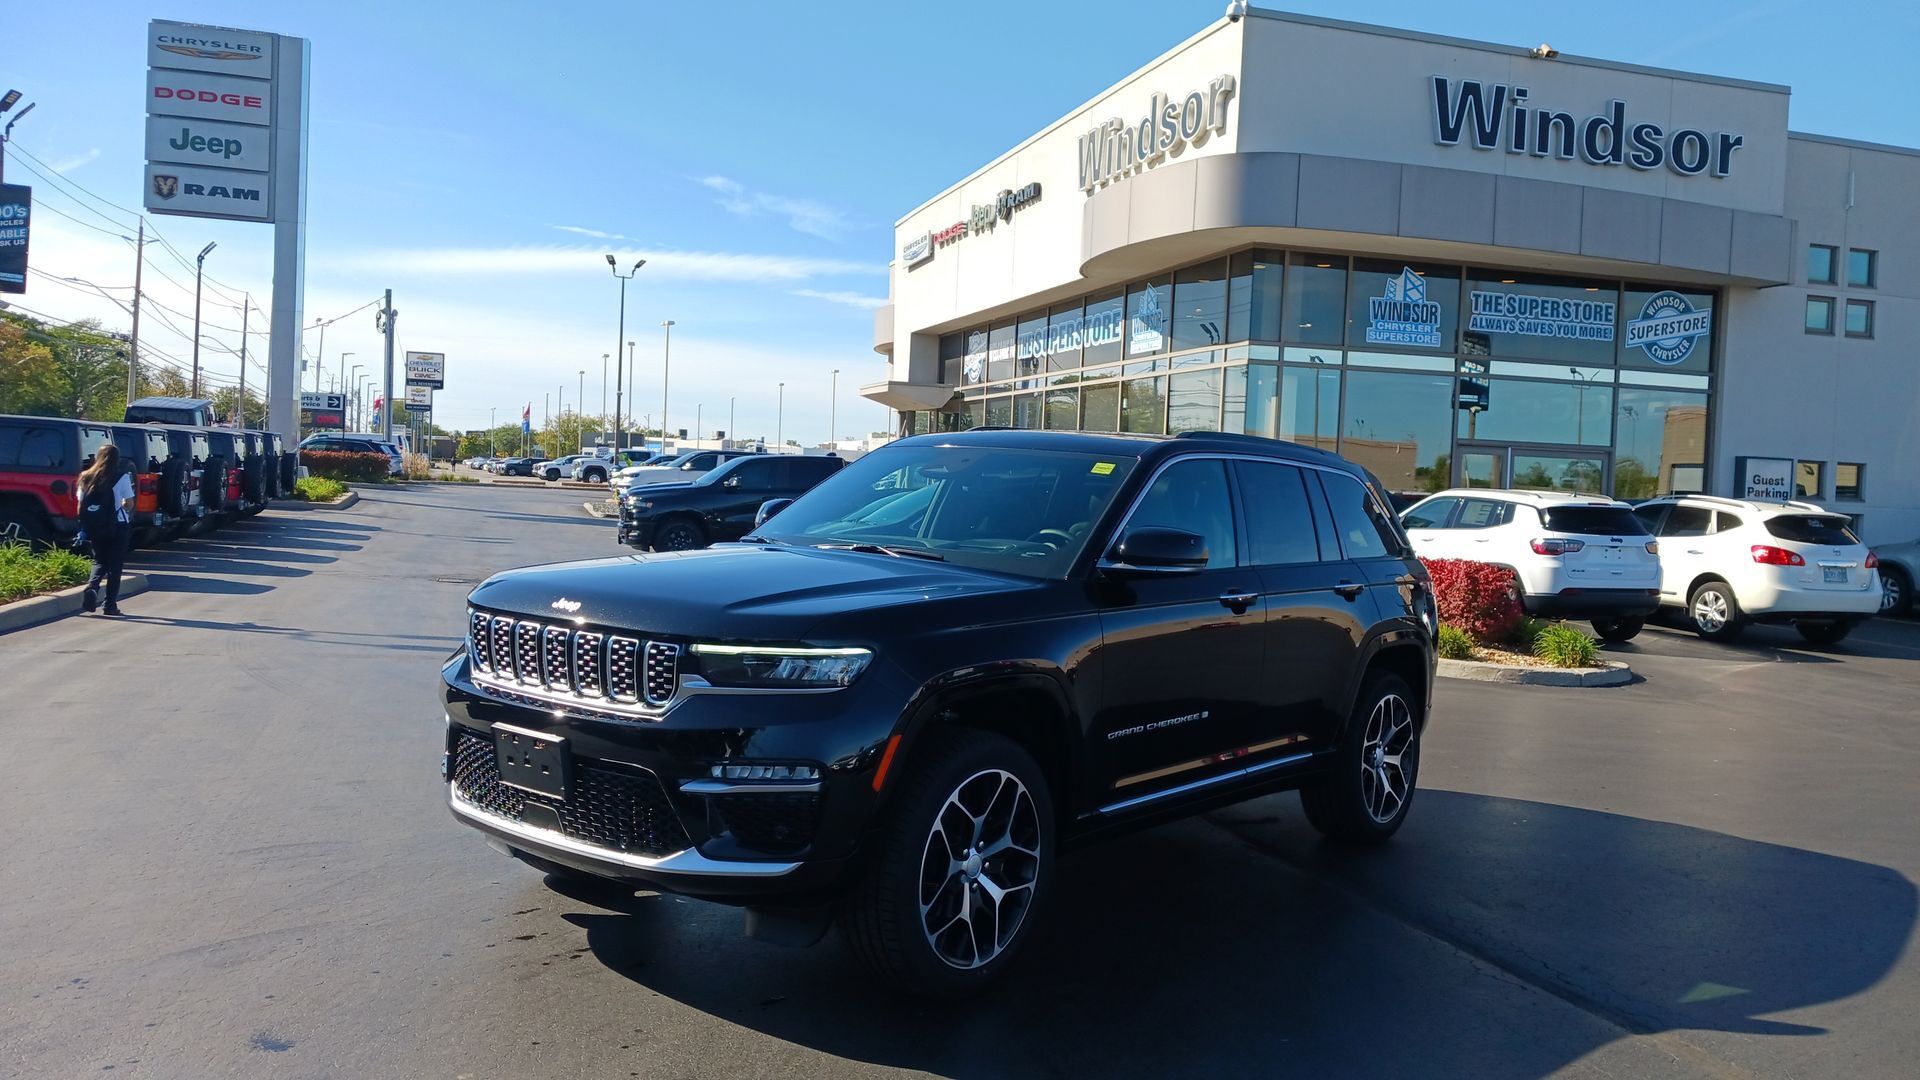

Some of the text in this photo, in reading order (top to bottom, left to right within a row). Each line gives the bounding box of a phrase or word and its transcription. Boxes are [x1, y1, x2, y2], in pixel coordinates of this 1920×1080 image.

[157, 35, 262, 53] CHRYSLER
[154, 86, 262, 108] DODGE
[1077, 74, 1235, 192] Windsor
[1431, 74, 1744, 177] Windsor
[169, 128, 242, 159] Jeep
[183, 183, 260, 201] RAM
[1007, 182, 1042, 208] RAM
[903, 235, 928, 253] CHRYSLER
[933, 221, 968, 245] DODGE
[1372, 300, 1439, 324] WINDSOR
[1471, 293, 1614, 323] THE SUPERSTORE
[1646, 296, 1686, 316] WINDSOR
[1033, 308, 1123, 358] SUPERSTORE
[1369, 331, 1440, 344] SUPERSTORE
[1377, 321, 1432, 333] CHRYSLER
[1471, 316, 1613, 340] ALWAYS SAVES YOU MORE!
[1629, 316, 1707, 341] SUPERSTORE
[1651, 339, 1691, 360] CHRYSLER
[1752, 474, 1785, 487] Guest
[1746, 486, 1789, 501] Parking
[552, 597, 581, 612] Jeep
[1107, 725, 1144, 740] GRAND
[1146, 712, 1200, 731] CHEROKEE
